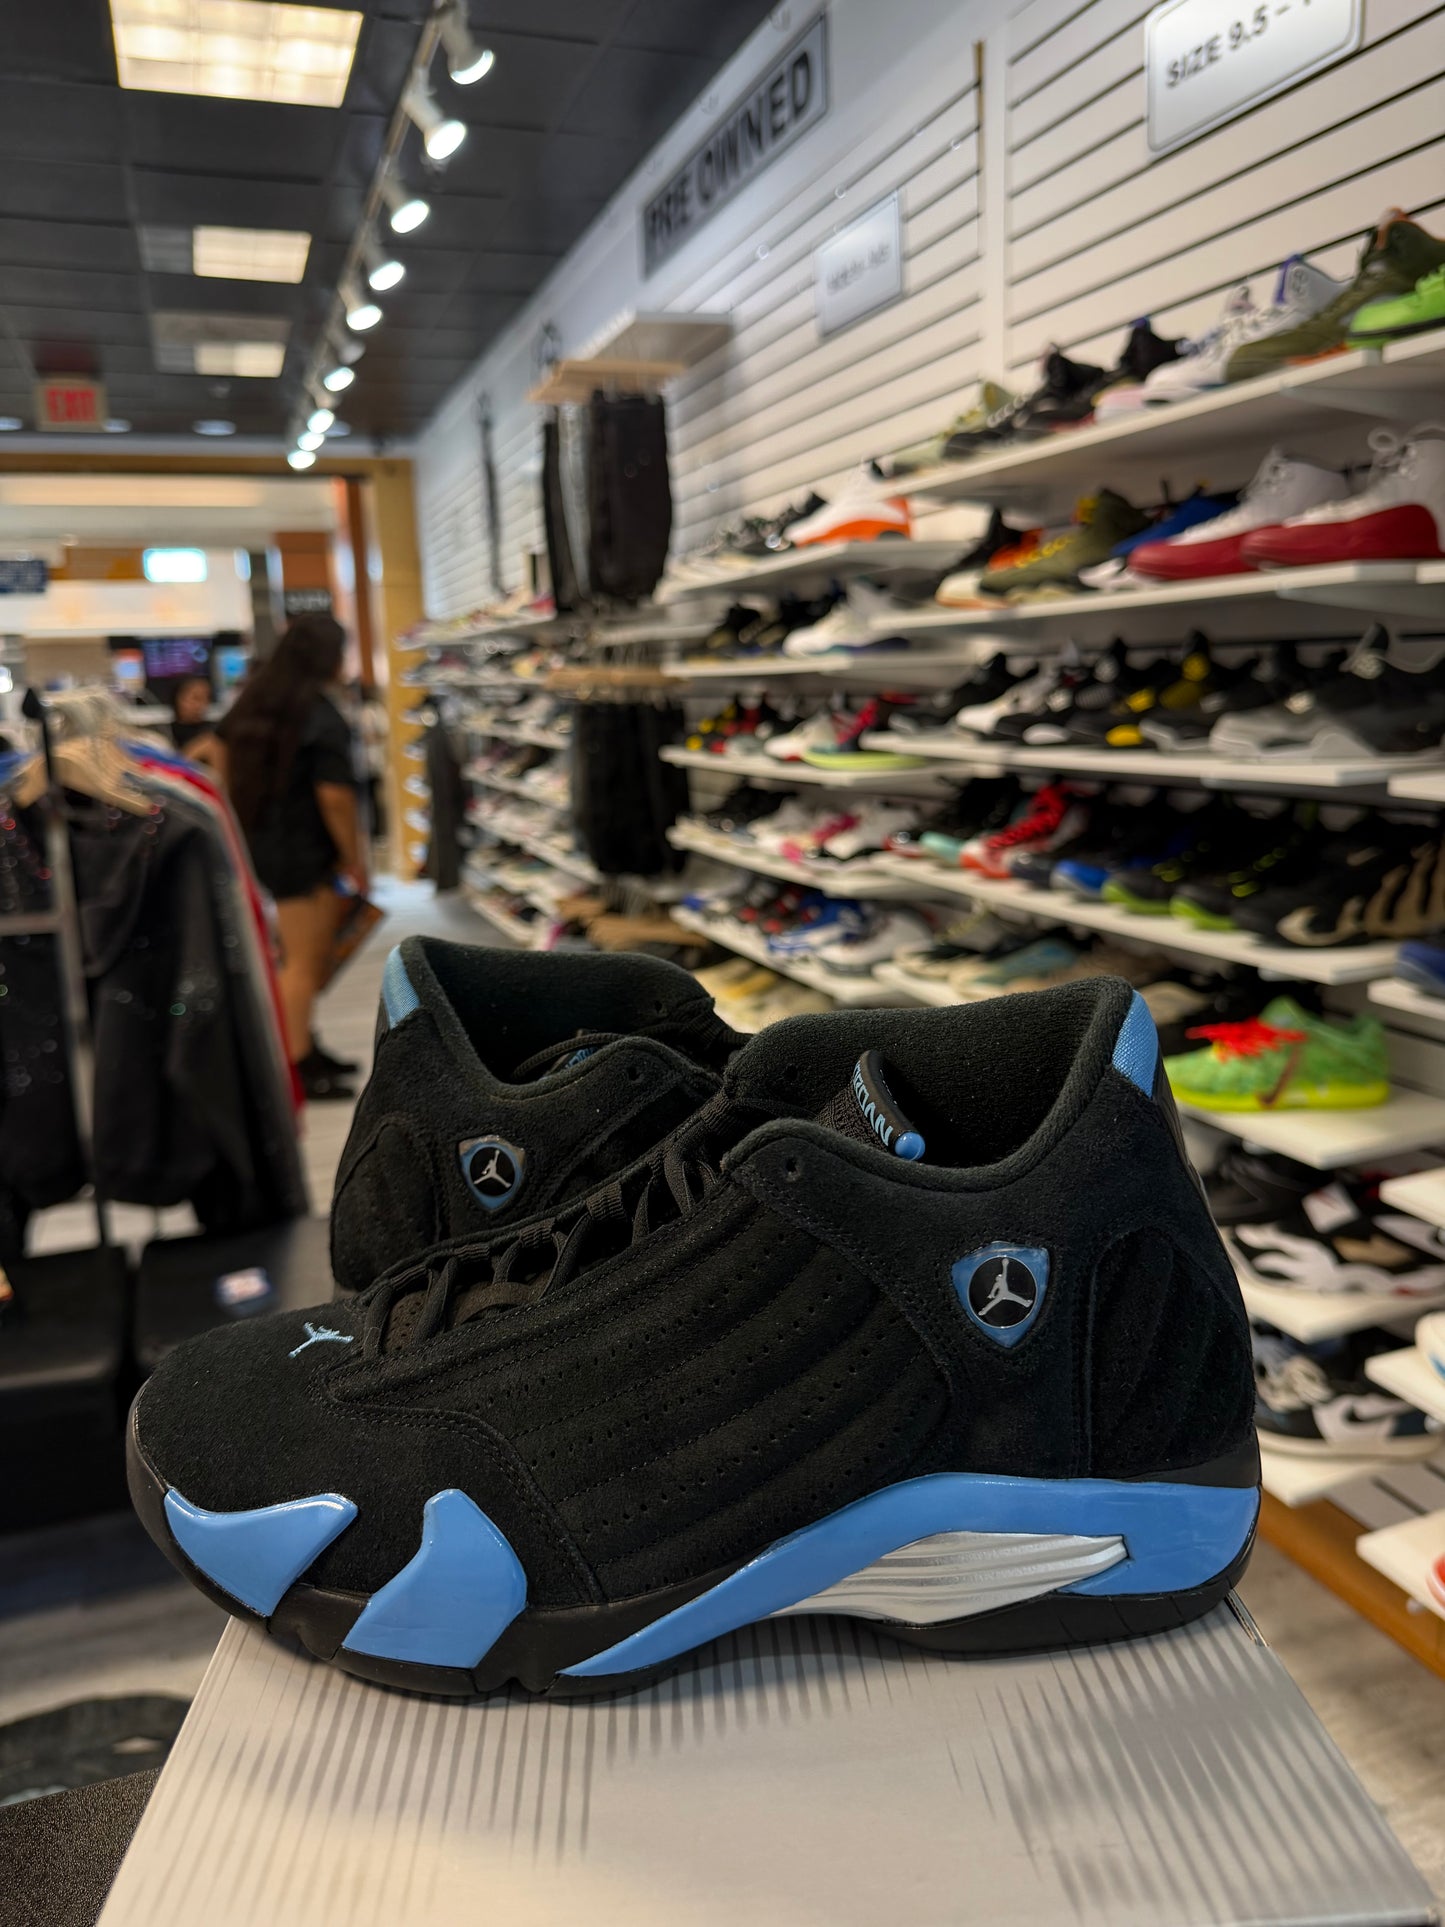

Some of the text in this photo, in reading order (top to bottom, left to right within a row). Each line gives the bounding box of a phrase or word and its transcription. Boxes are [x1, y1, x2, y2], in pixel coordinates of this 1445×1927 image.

[1166, 33, 1222, 88] SIZE
[1229, 5, 1267, 51] 9.5
[697, 51, 811, 206] OWNED
